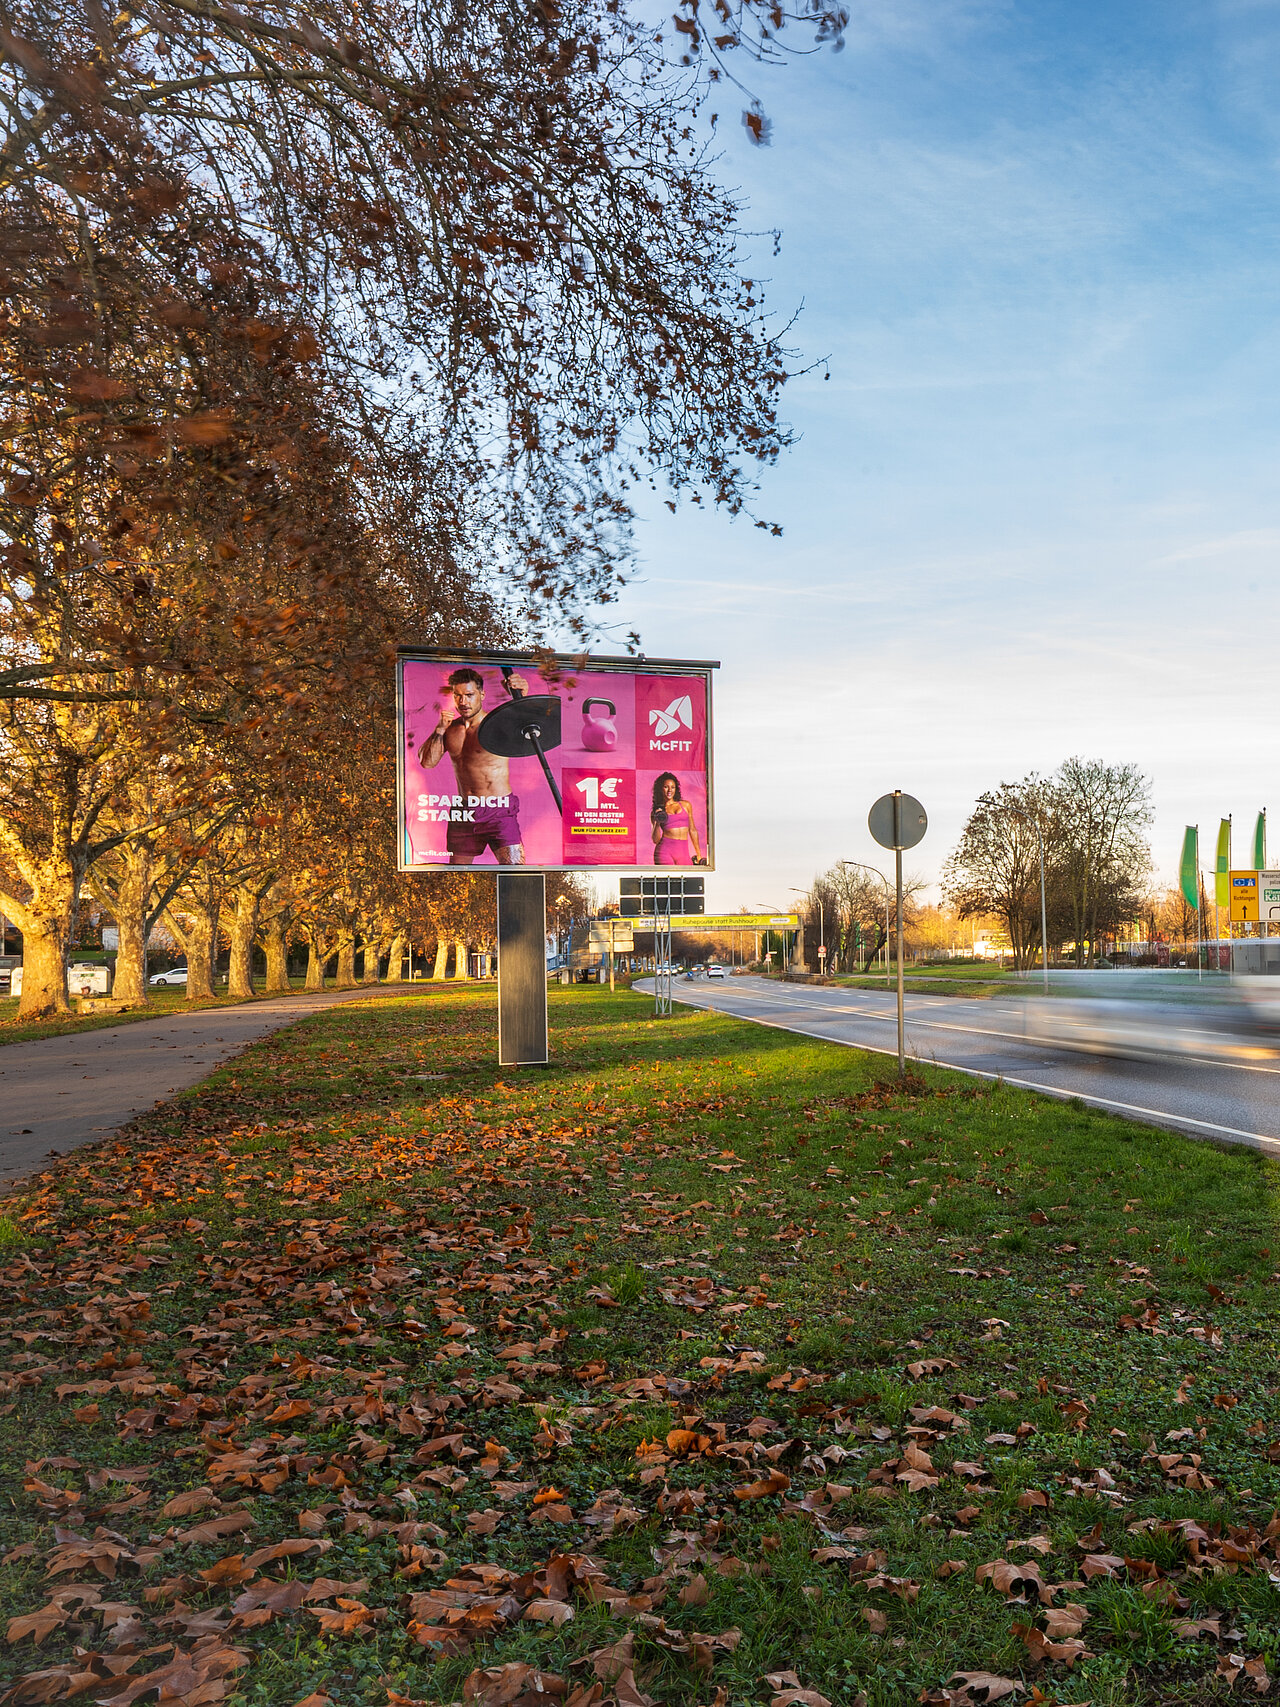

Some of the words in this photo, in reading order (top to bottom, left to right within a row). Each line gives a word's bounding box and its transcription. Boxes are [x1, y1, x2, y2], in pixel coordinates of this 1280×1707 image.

[649, 739, 692, 751] McFIT
[417, 794, 463, 807] SPAR
[467, 795, 510, 808] DICH
[417, 809, 475, 822] STARK
